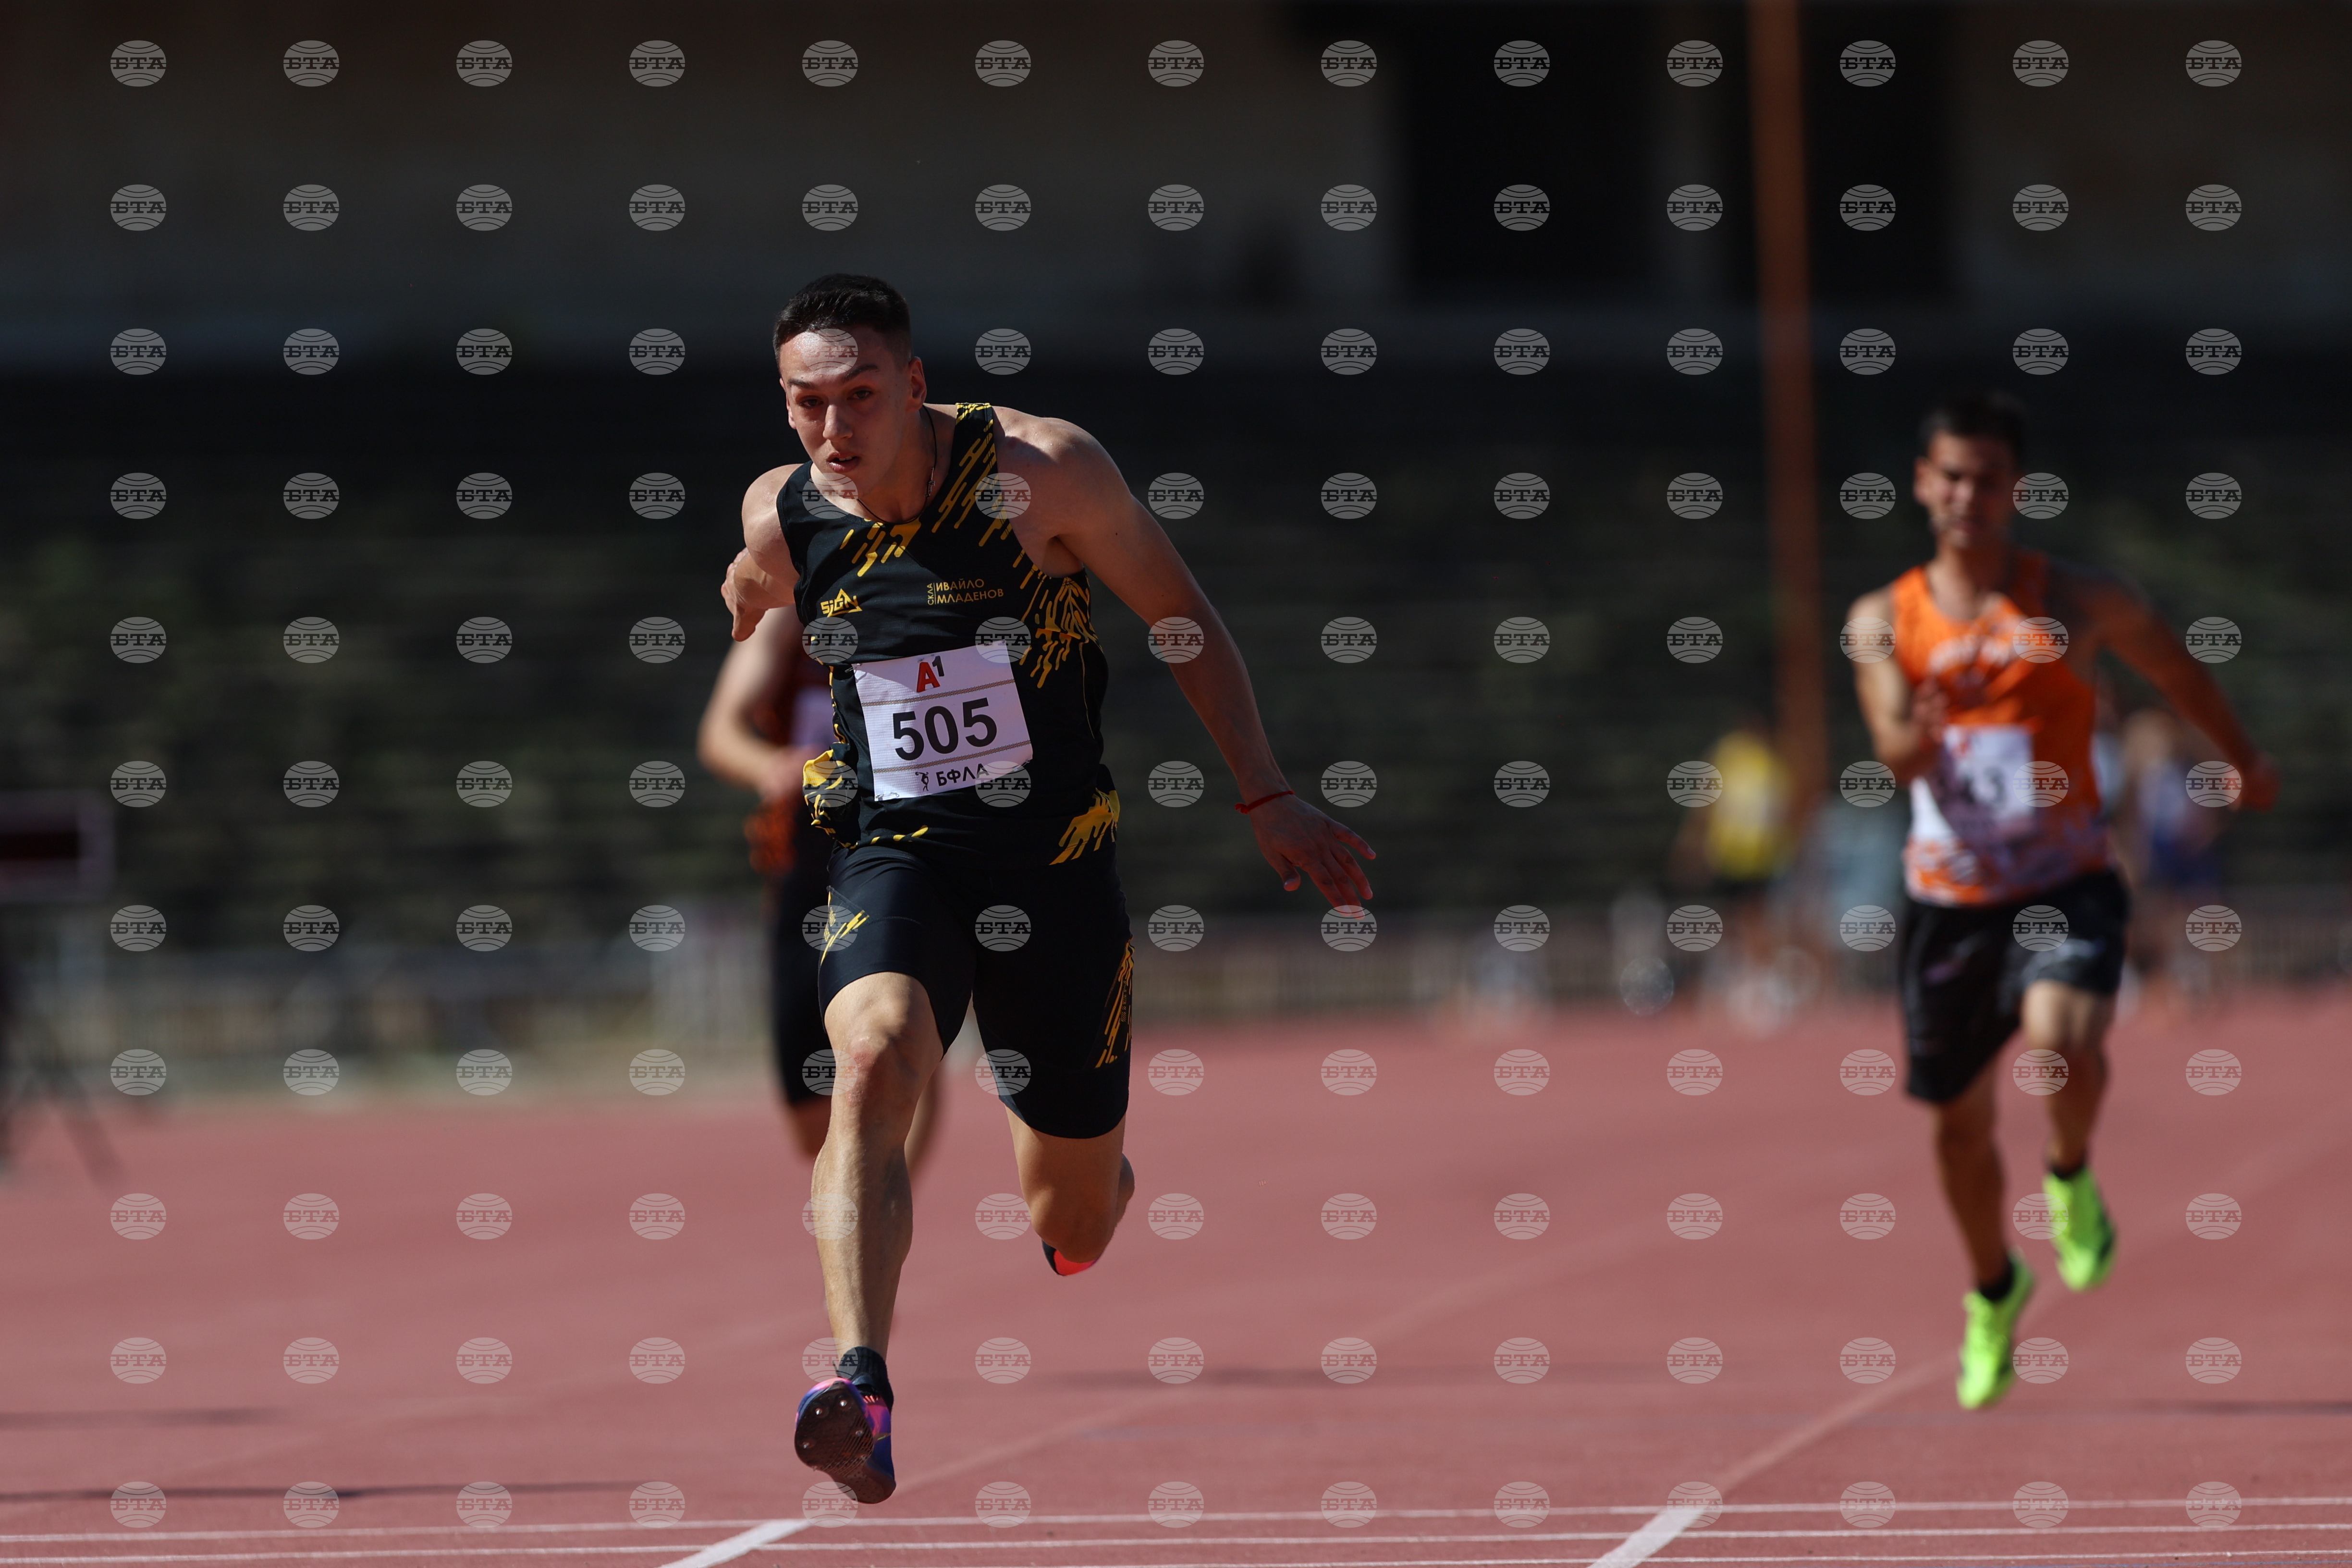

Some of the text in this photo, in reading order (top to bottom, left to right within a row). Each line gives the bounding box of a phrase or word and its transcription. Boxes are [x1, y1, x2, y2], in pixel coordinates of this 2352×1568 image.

[936, 578, 984, 591] ИВАЙЛО
[936, 588, 1004, 604] МЛАДЕНОВ
[893, 697, 997, 760] 505
[936, 763, 990, 786] БФЛА
